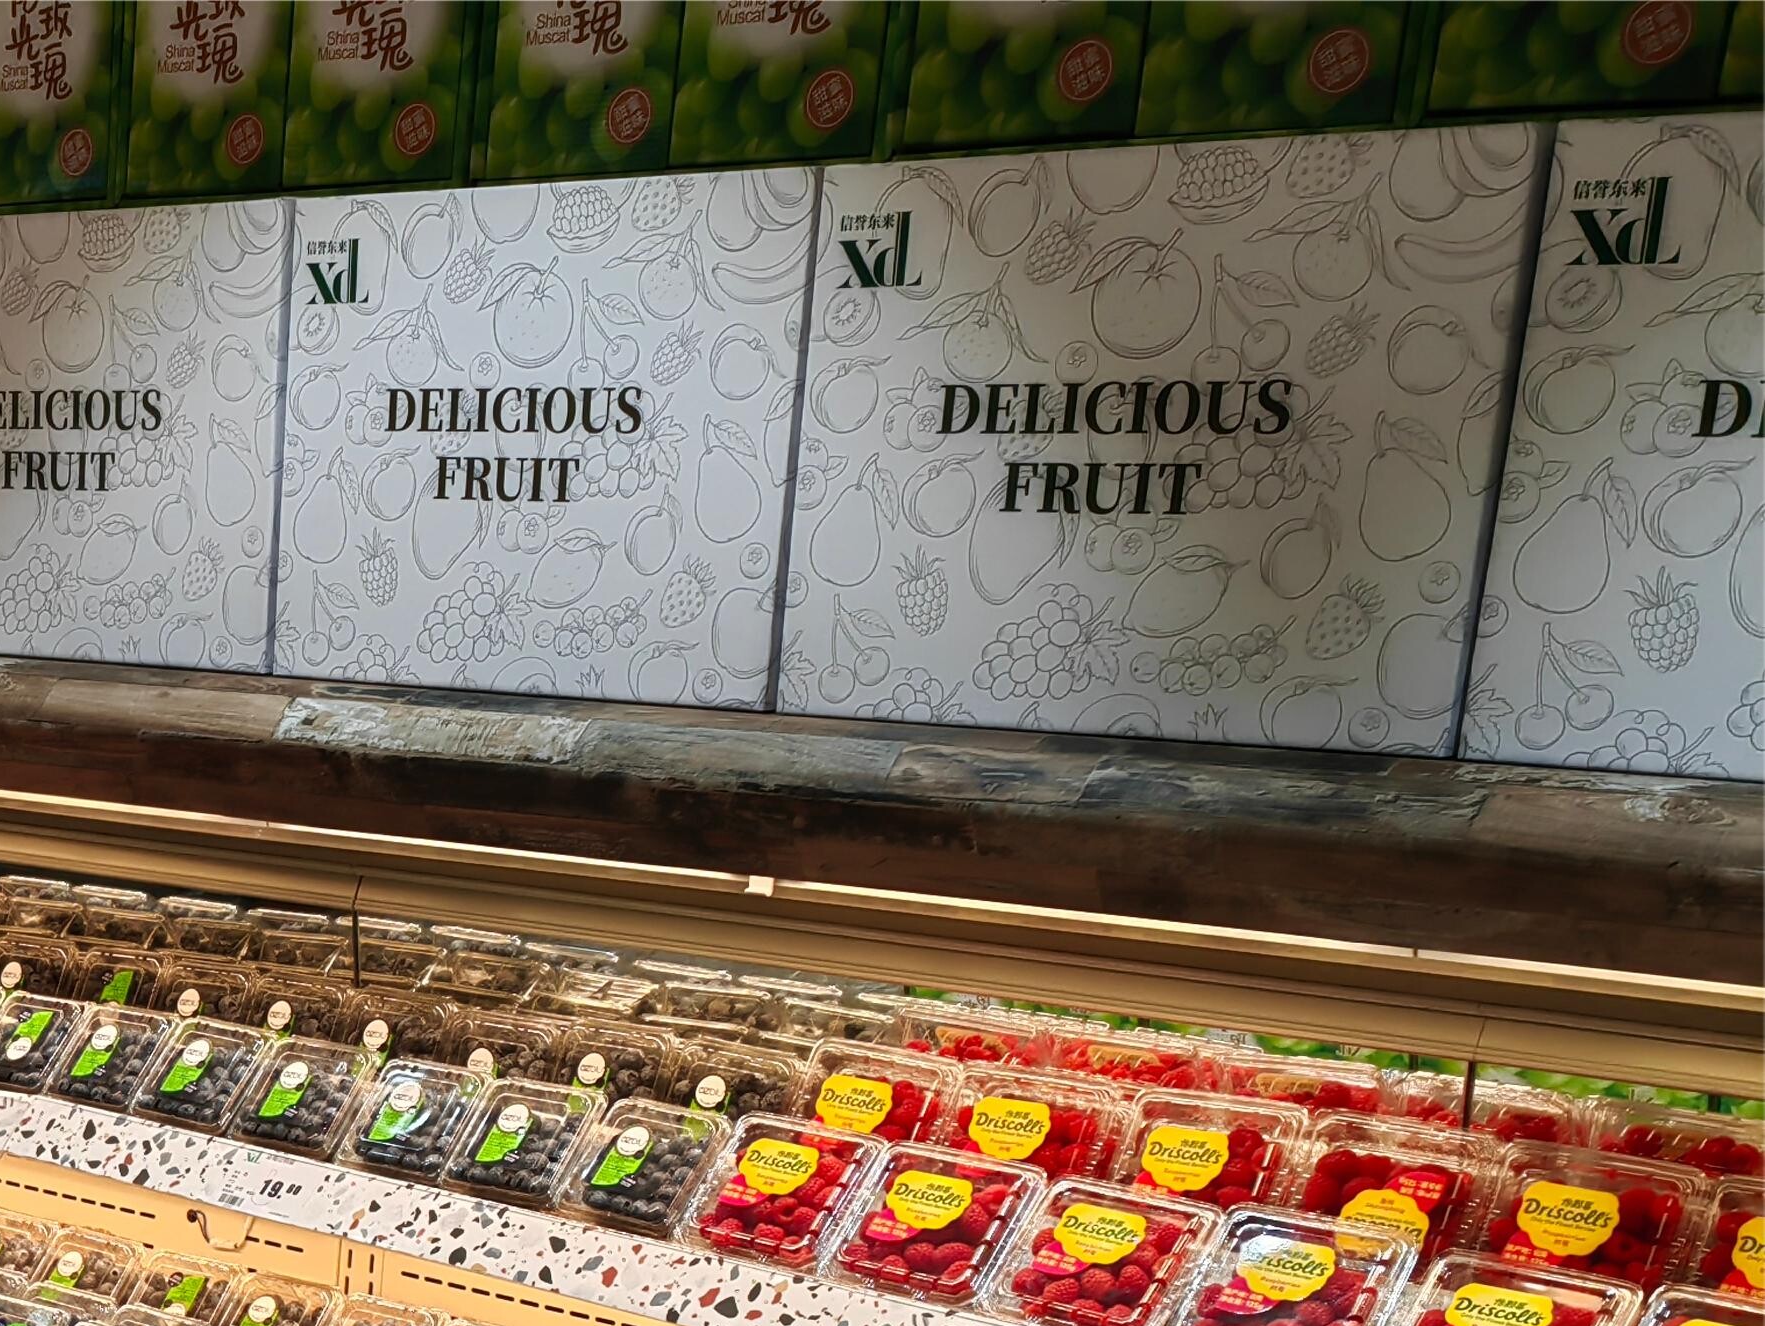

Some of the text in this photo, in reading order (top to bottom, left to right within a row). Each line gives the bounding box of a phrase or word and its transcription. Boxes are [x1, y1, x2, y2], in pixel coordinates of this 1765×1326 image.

[716, 9, 766, 26] Muscat
[526, 30, 570, 46] Muscat
[157, 58, 195, 74] Muscat
[318, 46, 358, 61] Muscat
[1572, 178, 1647, 202] 信誉东来
[839, 213, 896, 233] 信誉东来
[307, 239, 348, 256] 信誉东来
[385, 386, 644, 434] DELICIOUS
[936, 379, 1294, 437] DELICIOUS
[1, 451, 115, 492] FRUIT
[434, 456, 580, 502] FRUIT
[999, 461, 1202, 516] FRUIT
[824, 1087, 887, 1114] Driscoll's
[976, 1110, 1046, 1135] Driscoll's
[747, 1149, 813, 1173] Driscoll's
[1148, 1140, 1222, 1166] Driscoll's
[894, 1182, 965, 1209] Driscoll's
[1524, 1197, 1613, 1229] Driscoll's
[1062, 1214, 1140, 1243] Driscoll's
